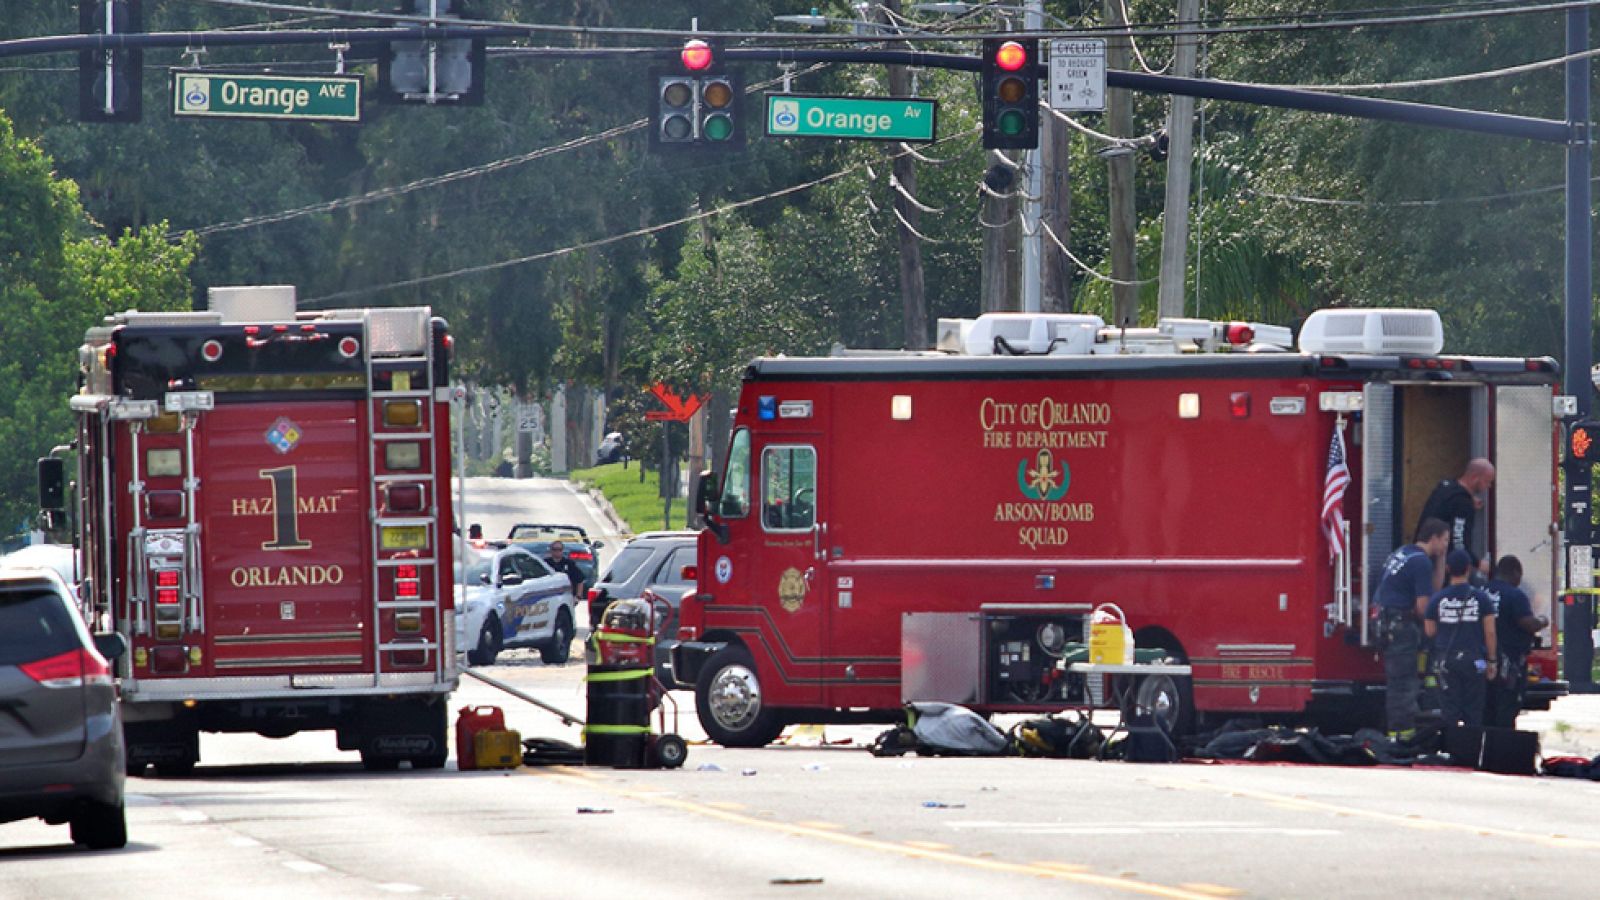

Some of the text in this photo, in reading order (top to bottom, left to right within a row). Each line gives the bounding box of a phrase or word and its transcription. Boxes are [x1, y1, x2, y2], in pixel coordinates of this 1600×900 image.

[1057, 44, 1097, 54] CYCLIST
[221, 80, 347, 114] Orange AVE
[807, 106, 921, 133] Orange Av
[520, 417, 537, 429] 25
[1021, 403, 1039, 425] OF
[983, 431, 1108, 448] FIRE DEPARTMENT
[232, 465, 341, 550] HAZ 1 MAT
[994, 503, 1094, 522] ARSON/BOMB
[1019, 527, 1068, 550] SQUAD
[231, 565, 343, 587] ORLANDO
[513, 601, 550, 616] POLICE
